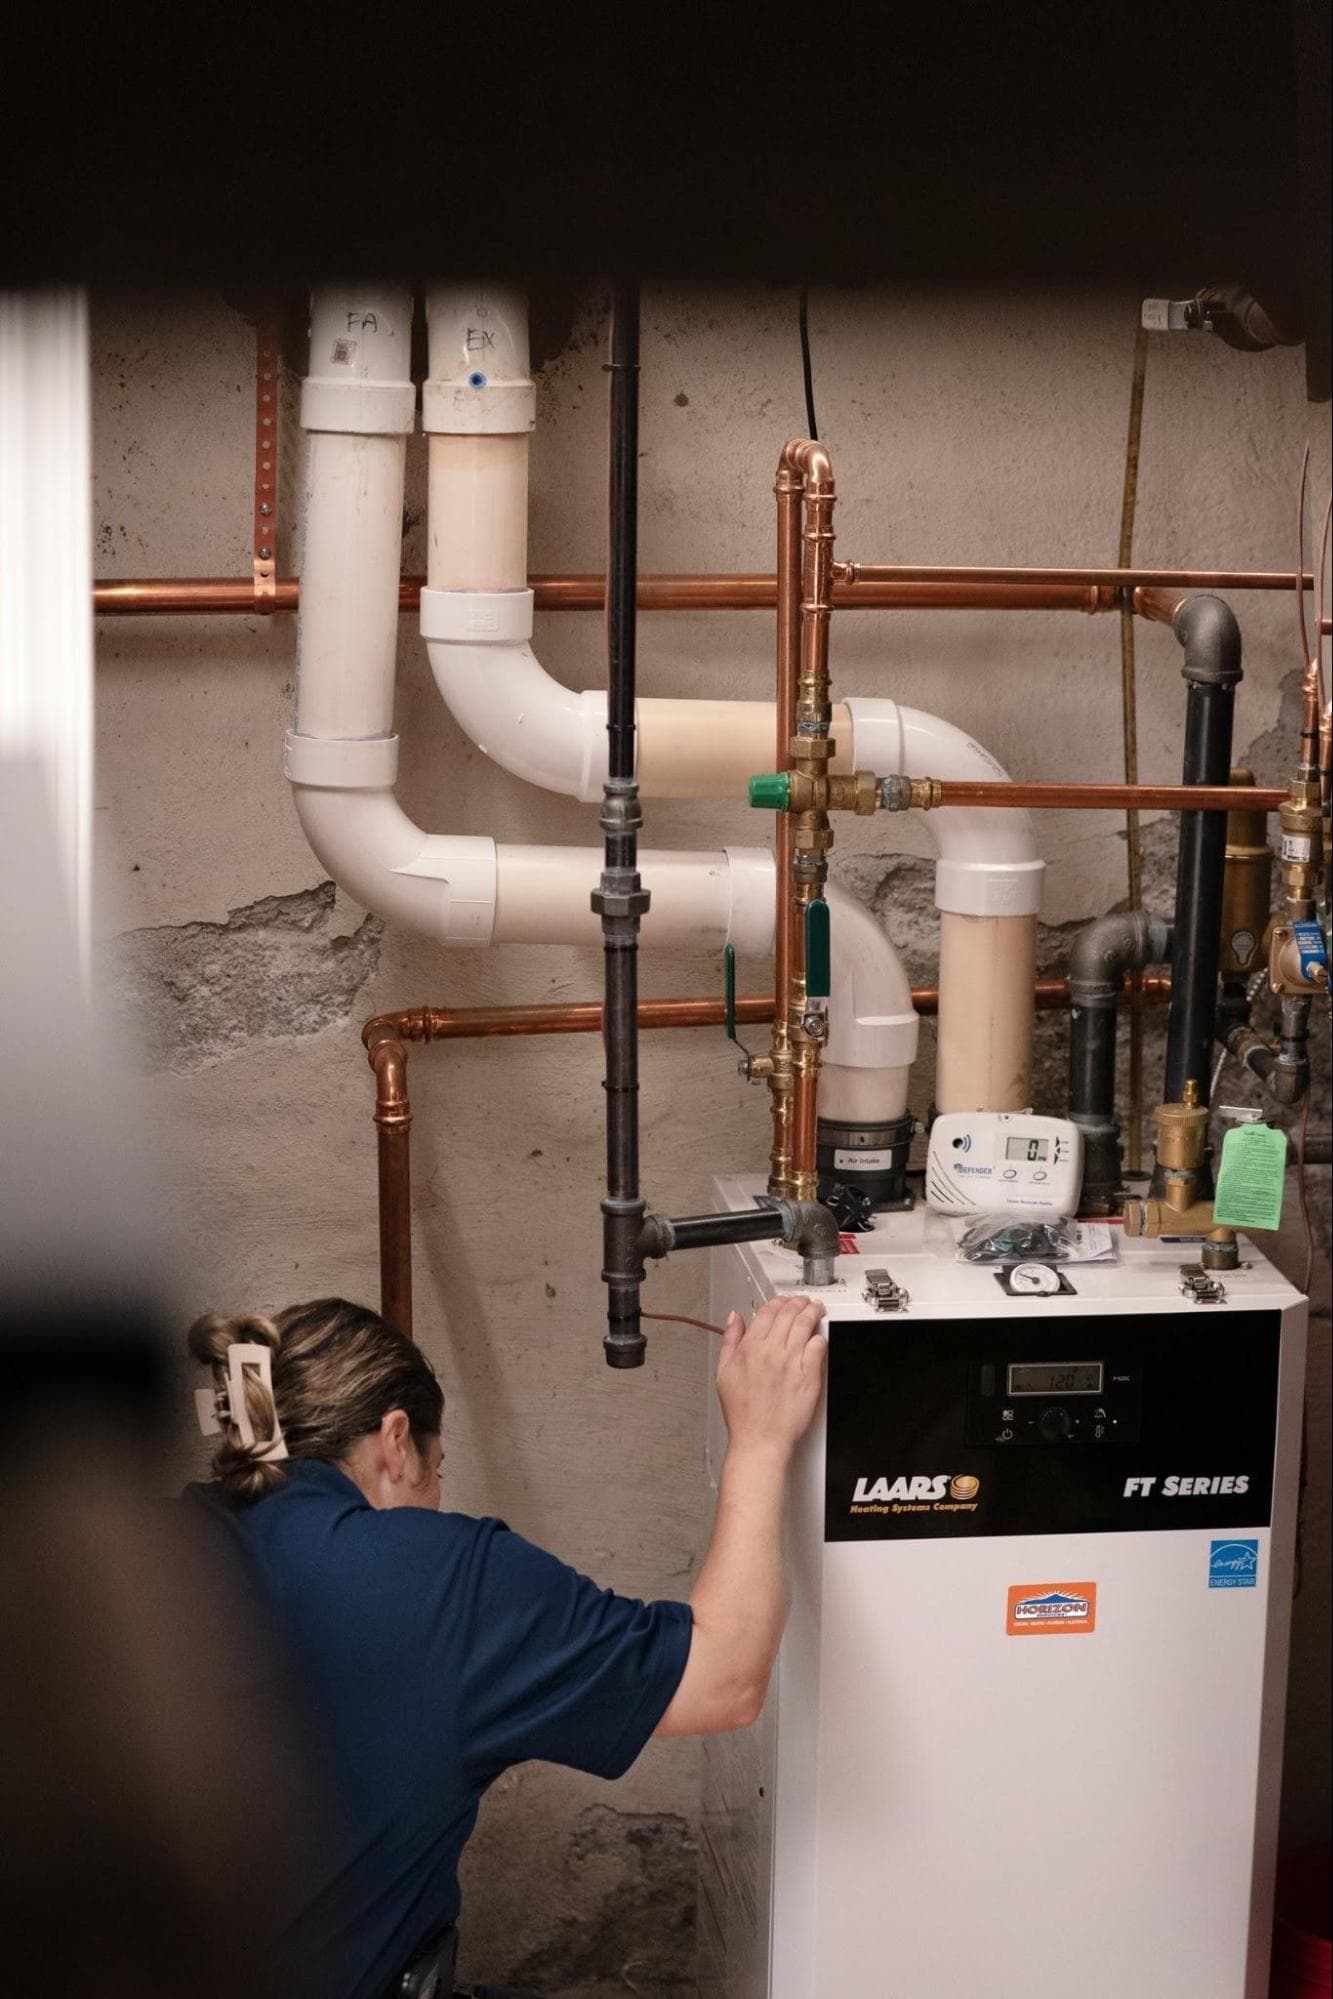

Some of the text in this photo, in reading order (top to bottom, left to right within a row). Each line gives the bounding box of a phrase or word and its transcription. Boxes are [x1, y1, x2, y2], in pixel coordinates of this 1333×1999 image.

[346, 312, 377, 333] FA
[465, 327, 496, 351] EX
[1027, 1139, 1039, 1161] 0
[959, 1166, 993, 1175] DEFENDER
[852, 1475, 951, 1502] LAARS
[1123, 1475, 1250, 1497] FT SERIES
[850, 1502, 978, 1514] Heating Systems Company
[1017, 1603, 1087, 1615] HORIZON
